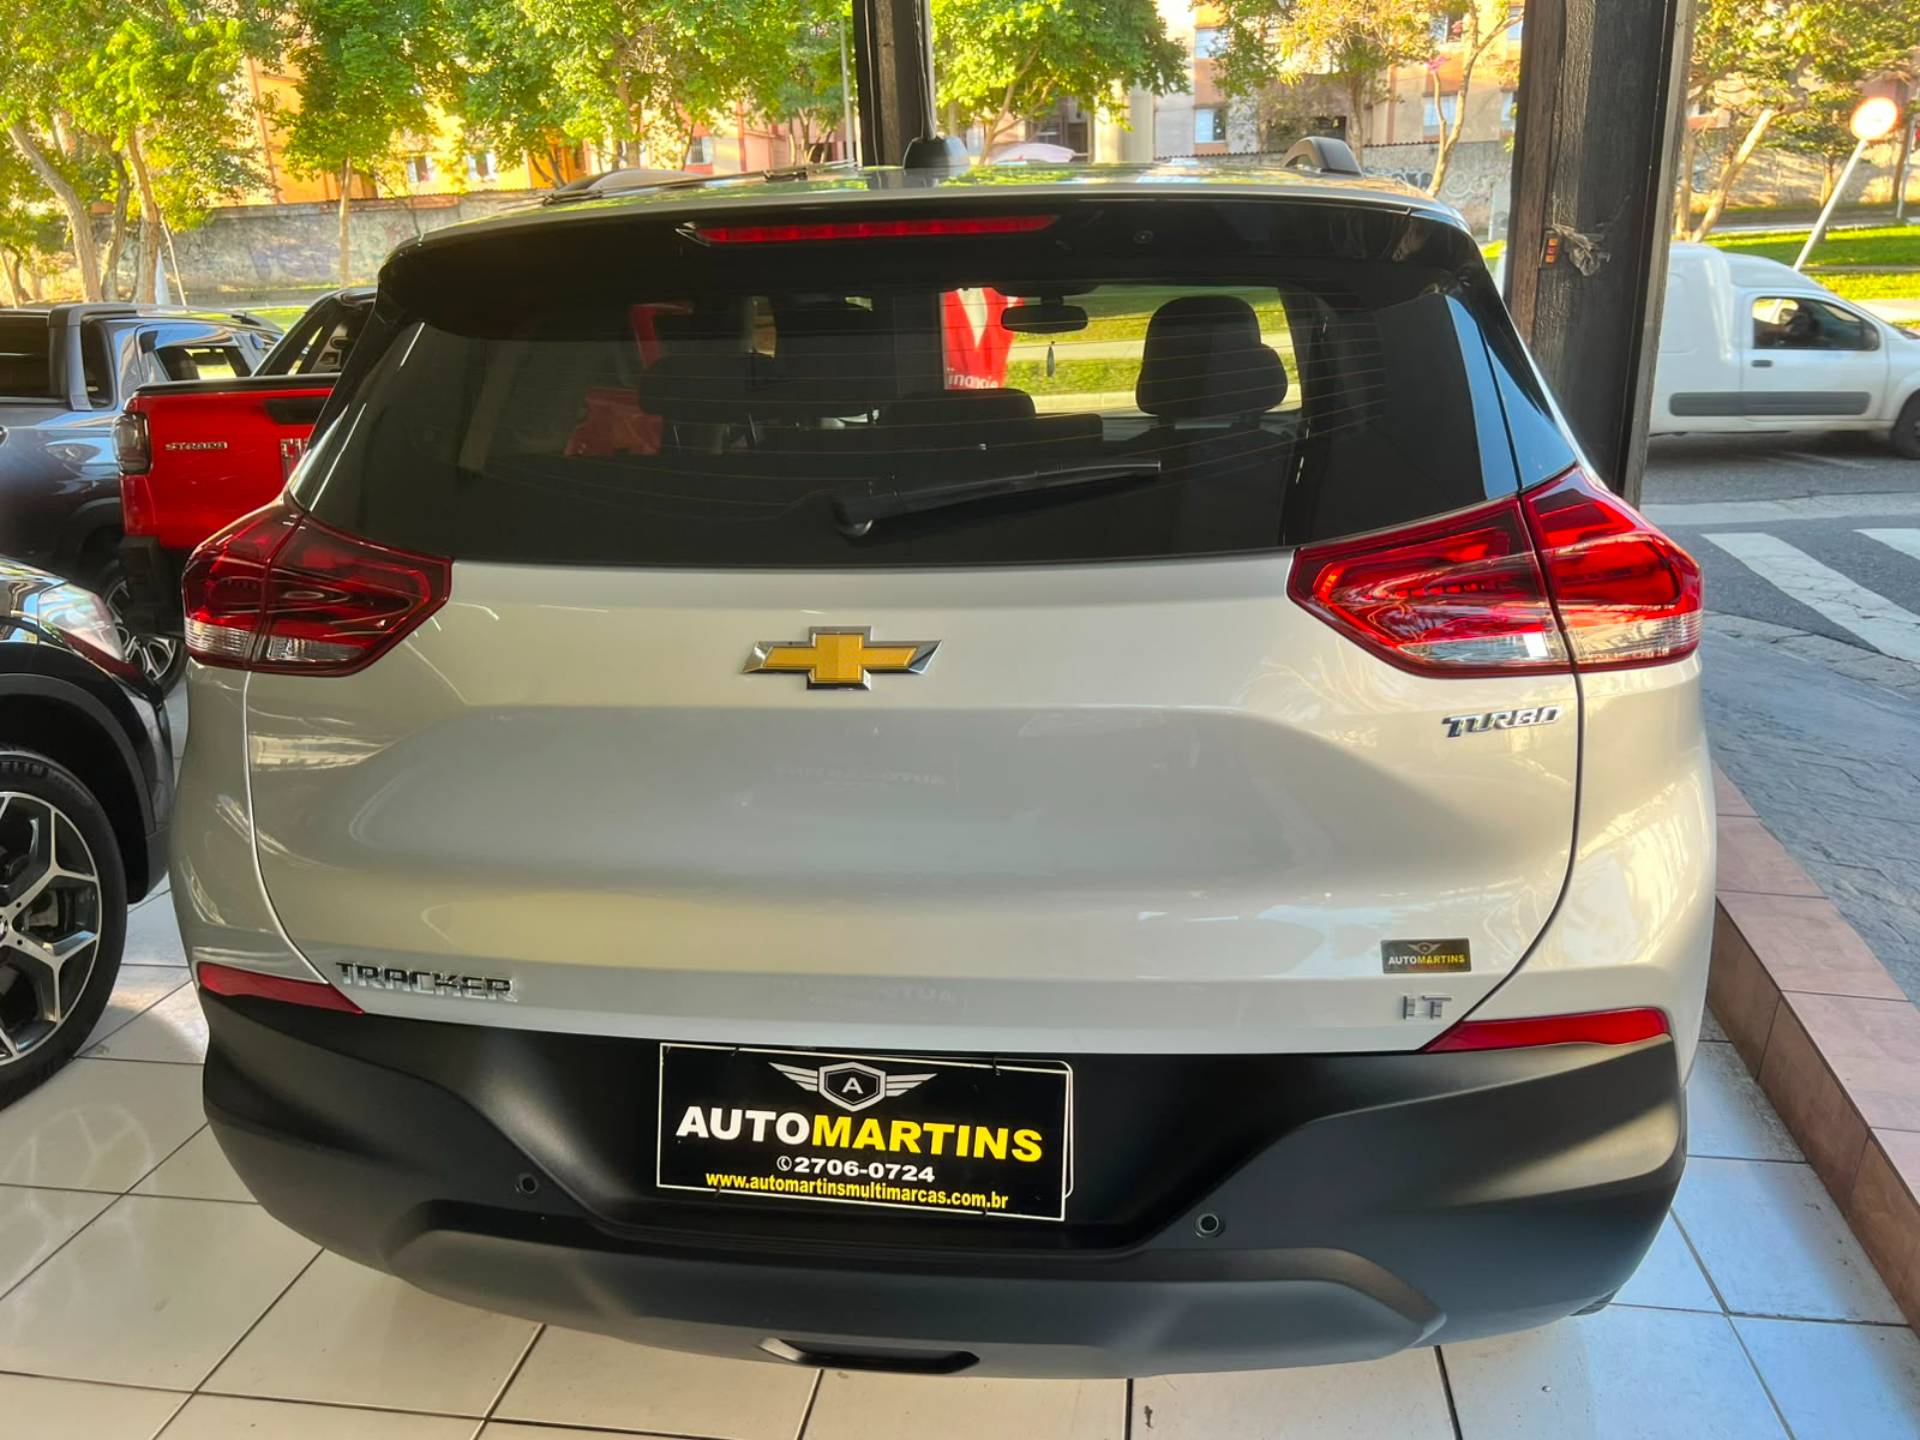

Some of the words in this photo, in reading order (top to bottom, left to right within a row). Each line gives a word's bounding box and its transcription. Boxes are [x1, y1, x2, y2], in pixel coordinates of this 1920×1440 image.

[1441, 704, 1563, 738] TURBO
[1388, 954, 1466, 965] AUTOMARTINS
[335, 961, 518, 1003] TRACKER
[841, 1077, 864, 1095] A
[675, 1105, 1043, 1163] AUTOMARTINS
[793, 1156, 936, 1183] 2706-0724
[705, 1171, 1009, 1209] www.automartinsmultimarcas.com.br
